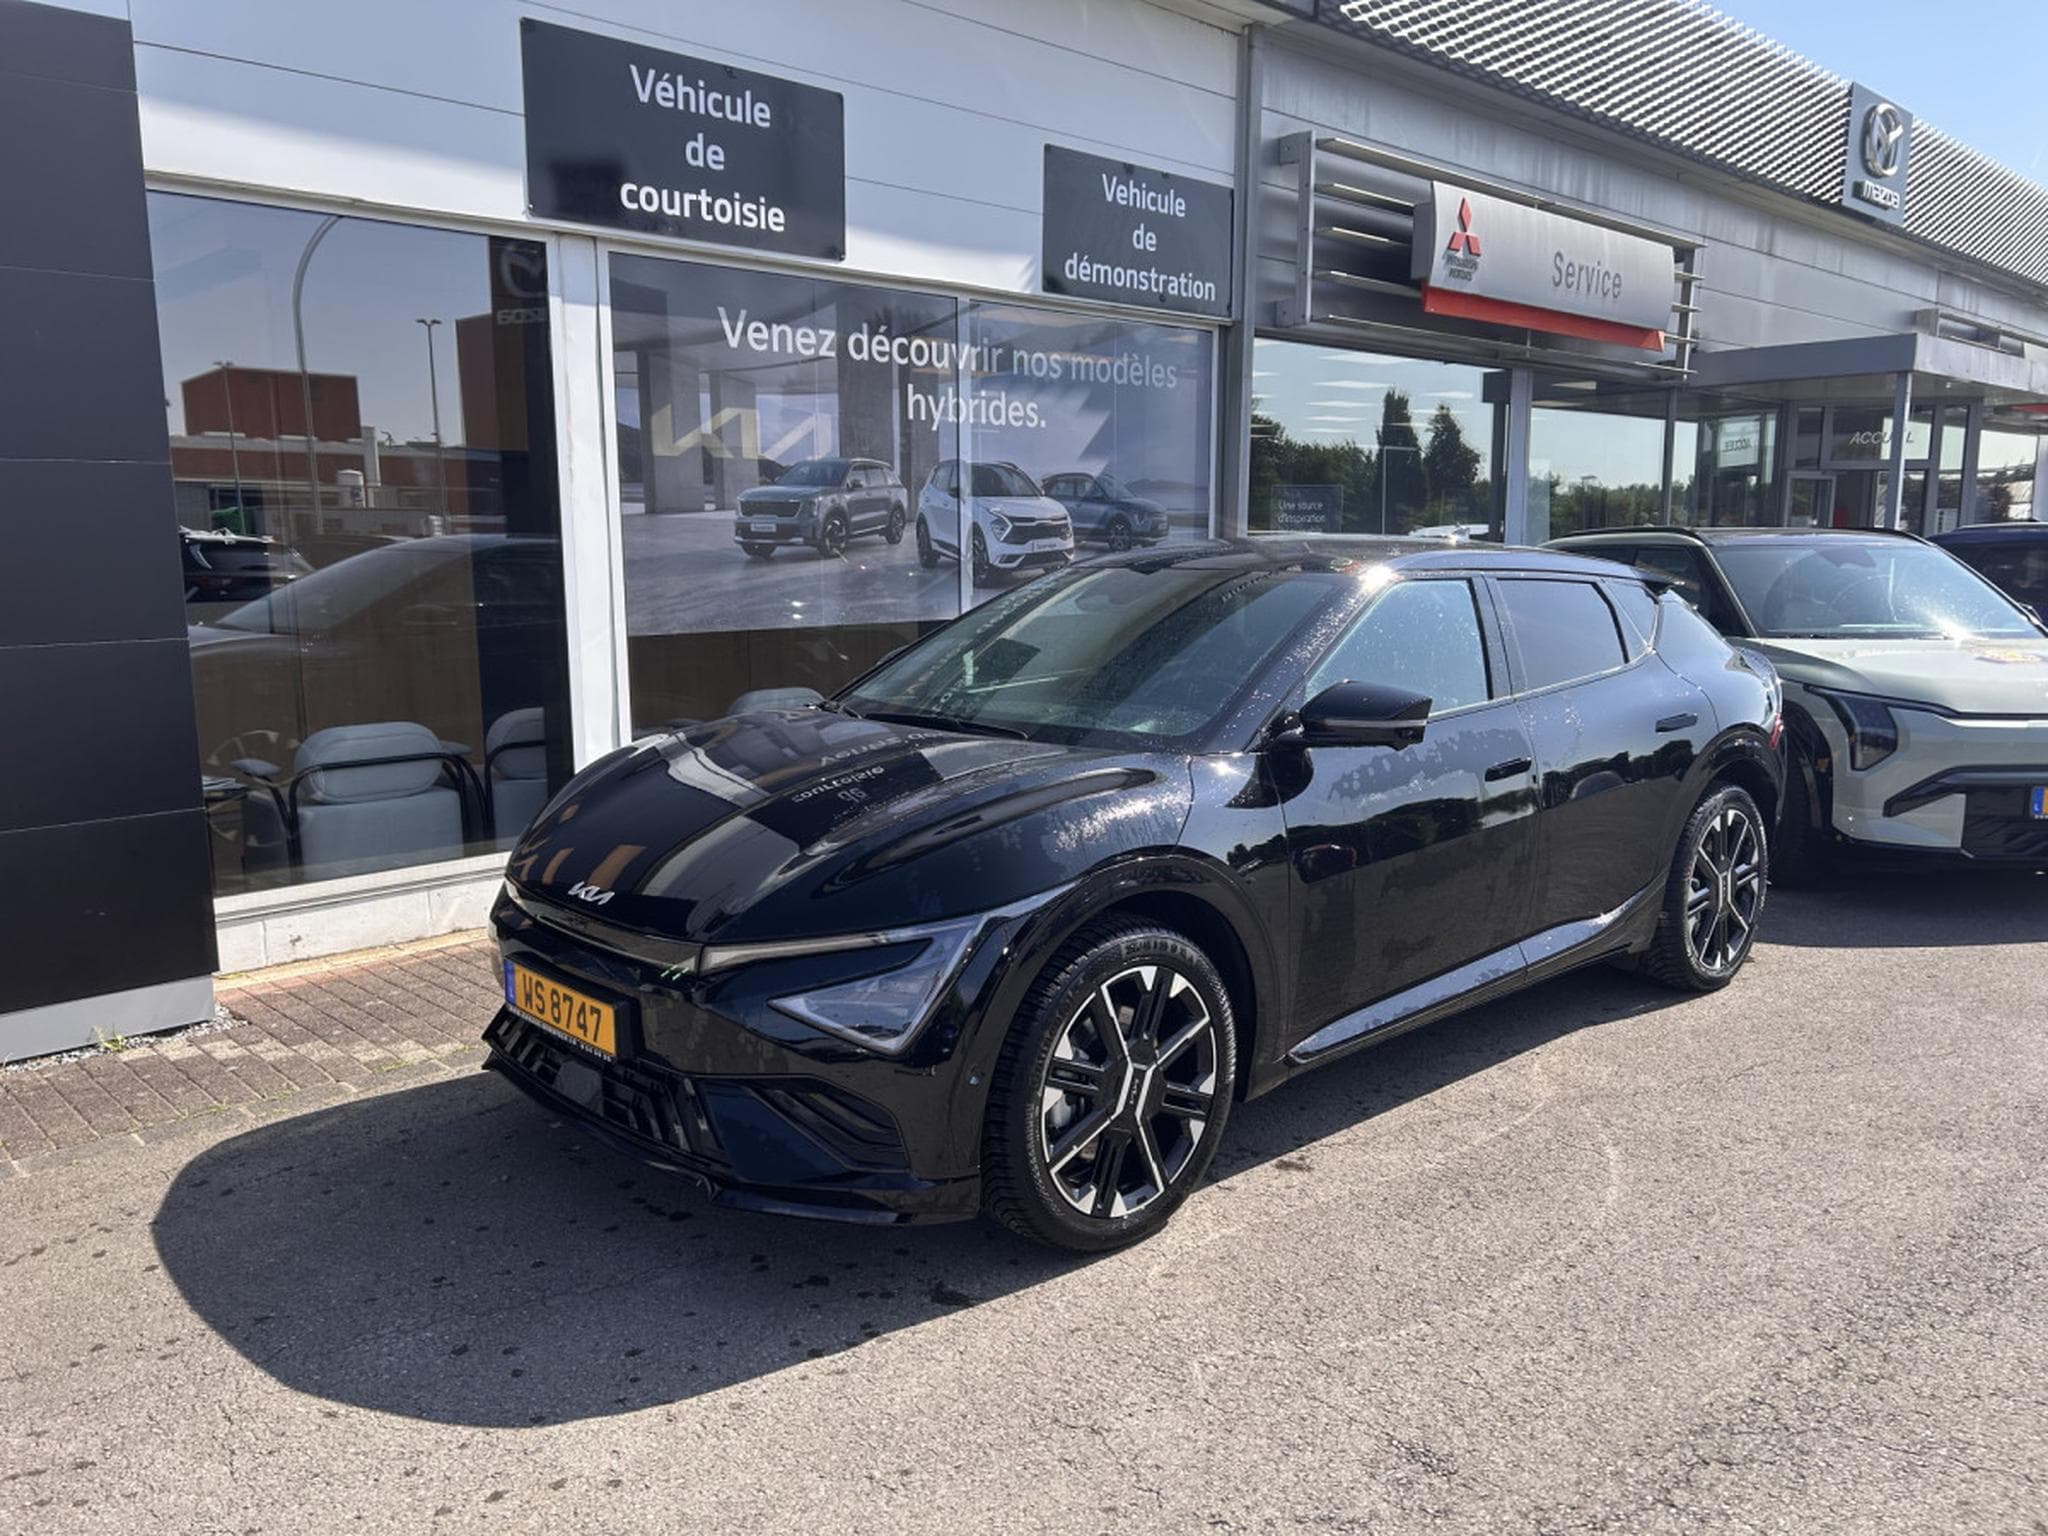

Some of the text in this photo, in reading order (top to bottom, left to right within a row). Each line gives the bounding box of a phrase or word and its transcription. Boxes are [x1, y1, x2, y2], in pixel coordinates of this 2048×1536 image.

[629, 64, 771, 128] Véhicule
[685, 133, 725, 170] de
[620, 182, 785, 232] courtoisie
[1102, 173, 1186, 217] Vehicule
[1132, 223, 1157, 251] de
[1064, 252, 1216, 301] démonstration
[1552, 250, 1622, 299] Service
[717, 306, 1178, 389] Venez découvrir nos modèles
[907, 383, 1047, 431] hybrides.
[1849, 431, 1914, 445] ACCUL
